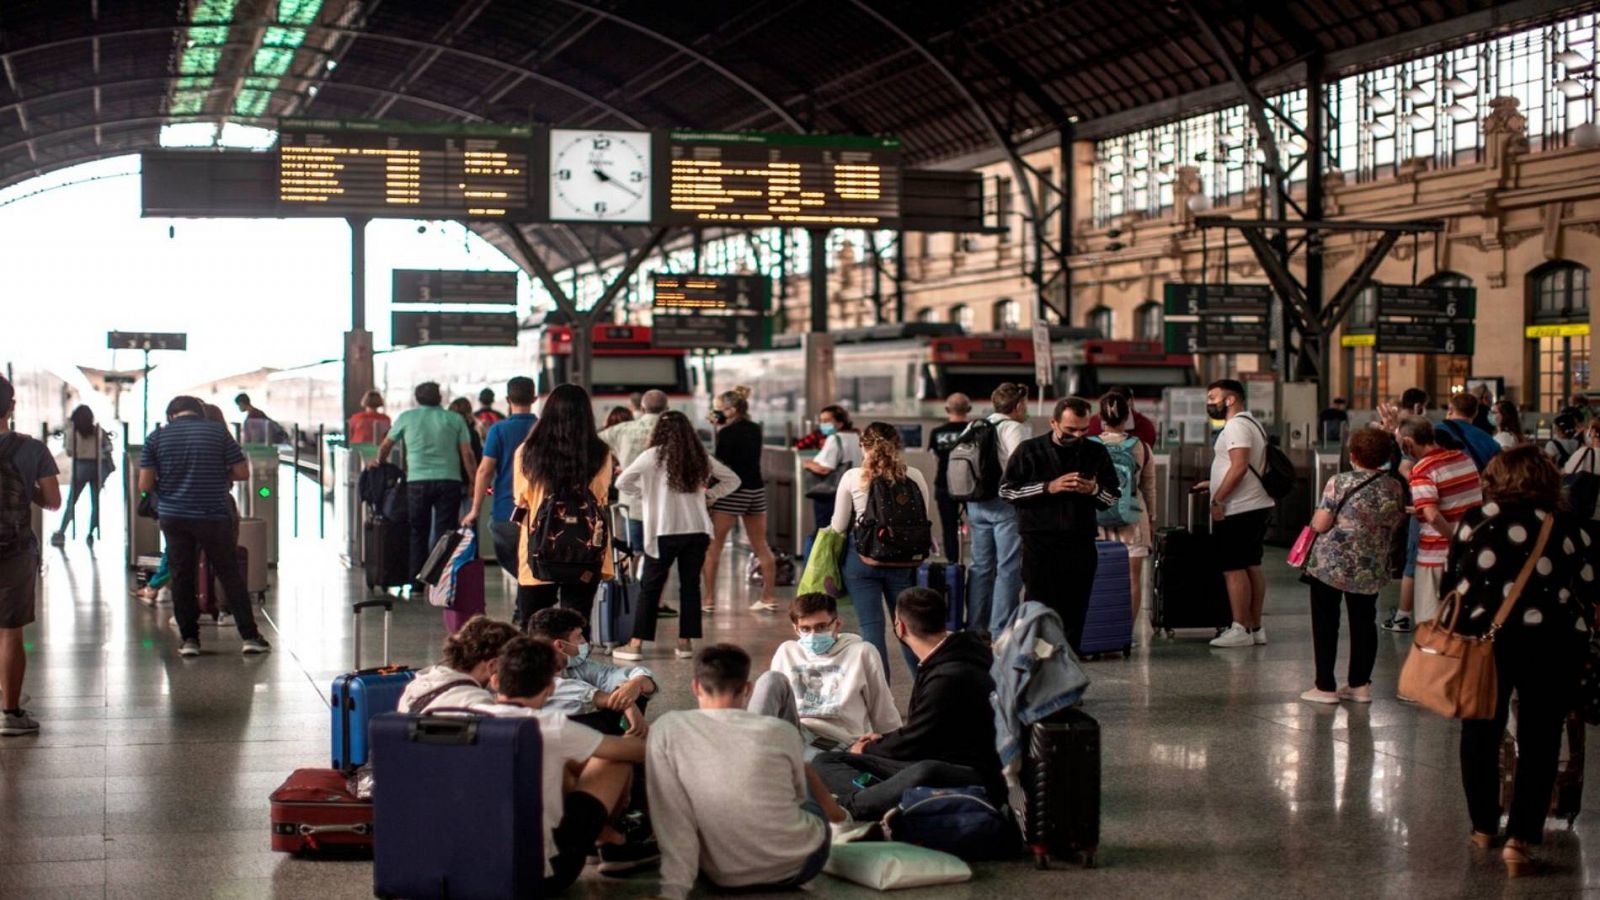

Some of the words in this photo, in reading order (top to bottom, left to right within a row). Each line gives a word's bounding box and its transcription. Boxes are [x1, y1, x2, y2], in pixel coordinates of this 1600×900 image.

[593, 139, 610, 150] 12
[559, 169, 571, 180] 9
[630, 171, 643, 182] 3
[594, 202, 607, 213] 6
[1188, 300, 1198, 314] 5
[1446, 303, 1457, 316] 6
[1188, 338, 1198, 352] 5
[1445, 339, 1455, 353] 6
